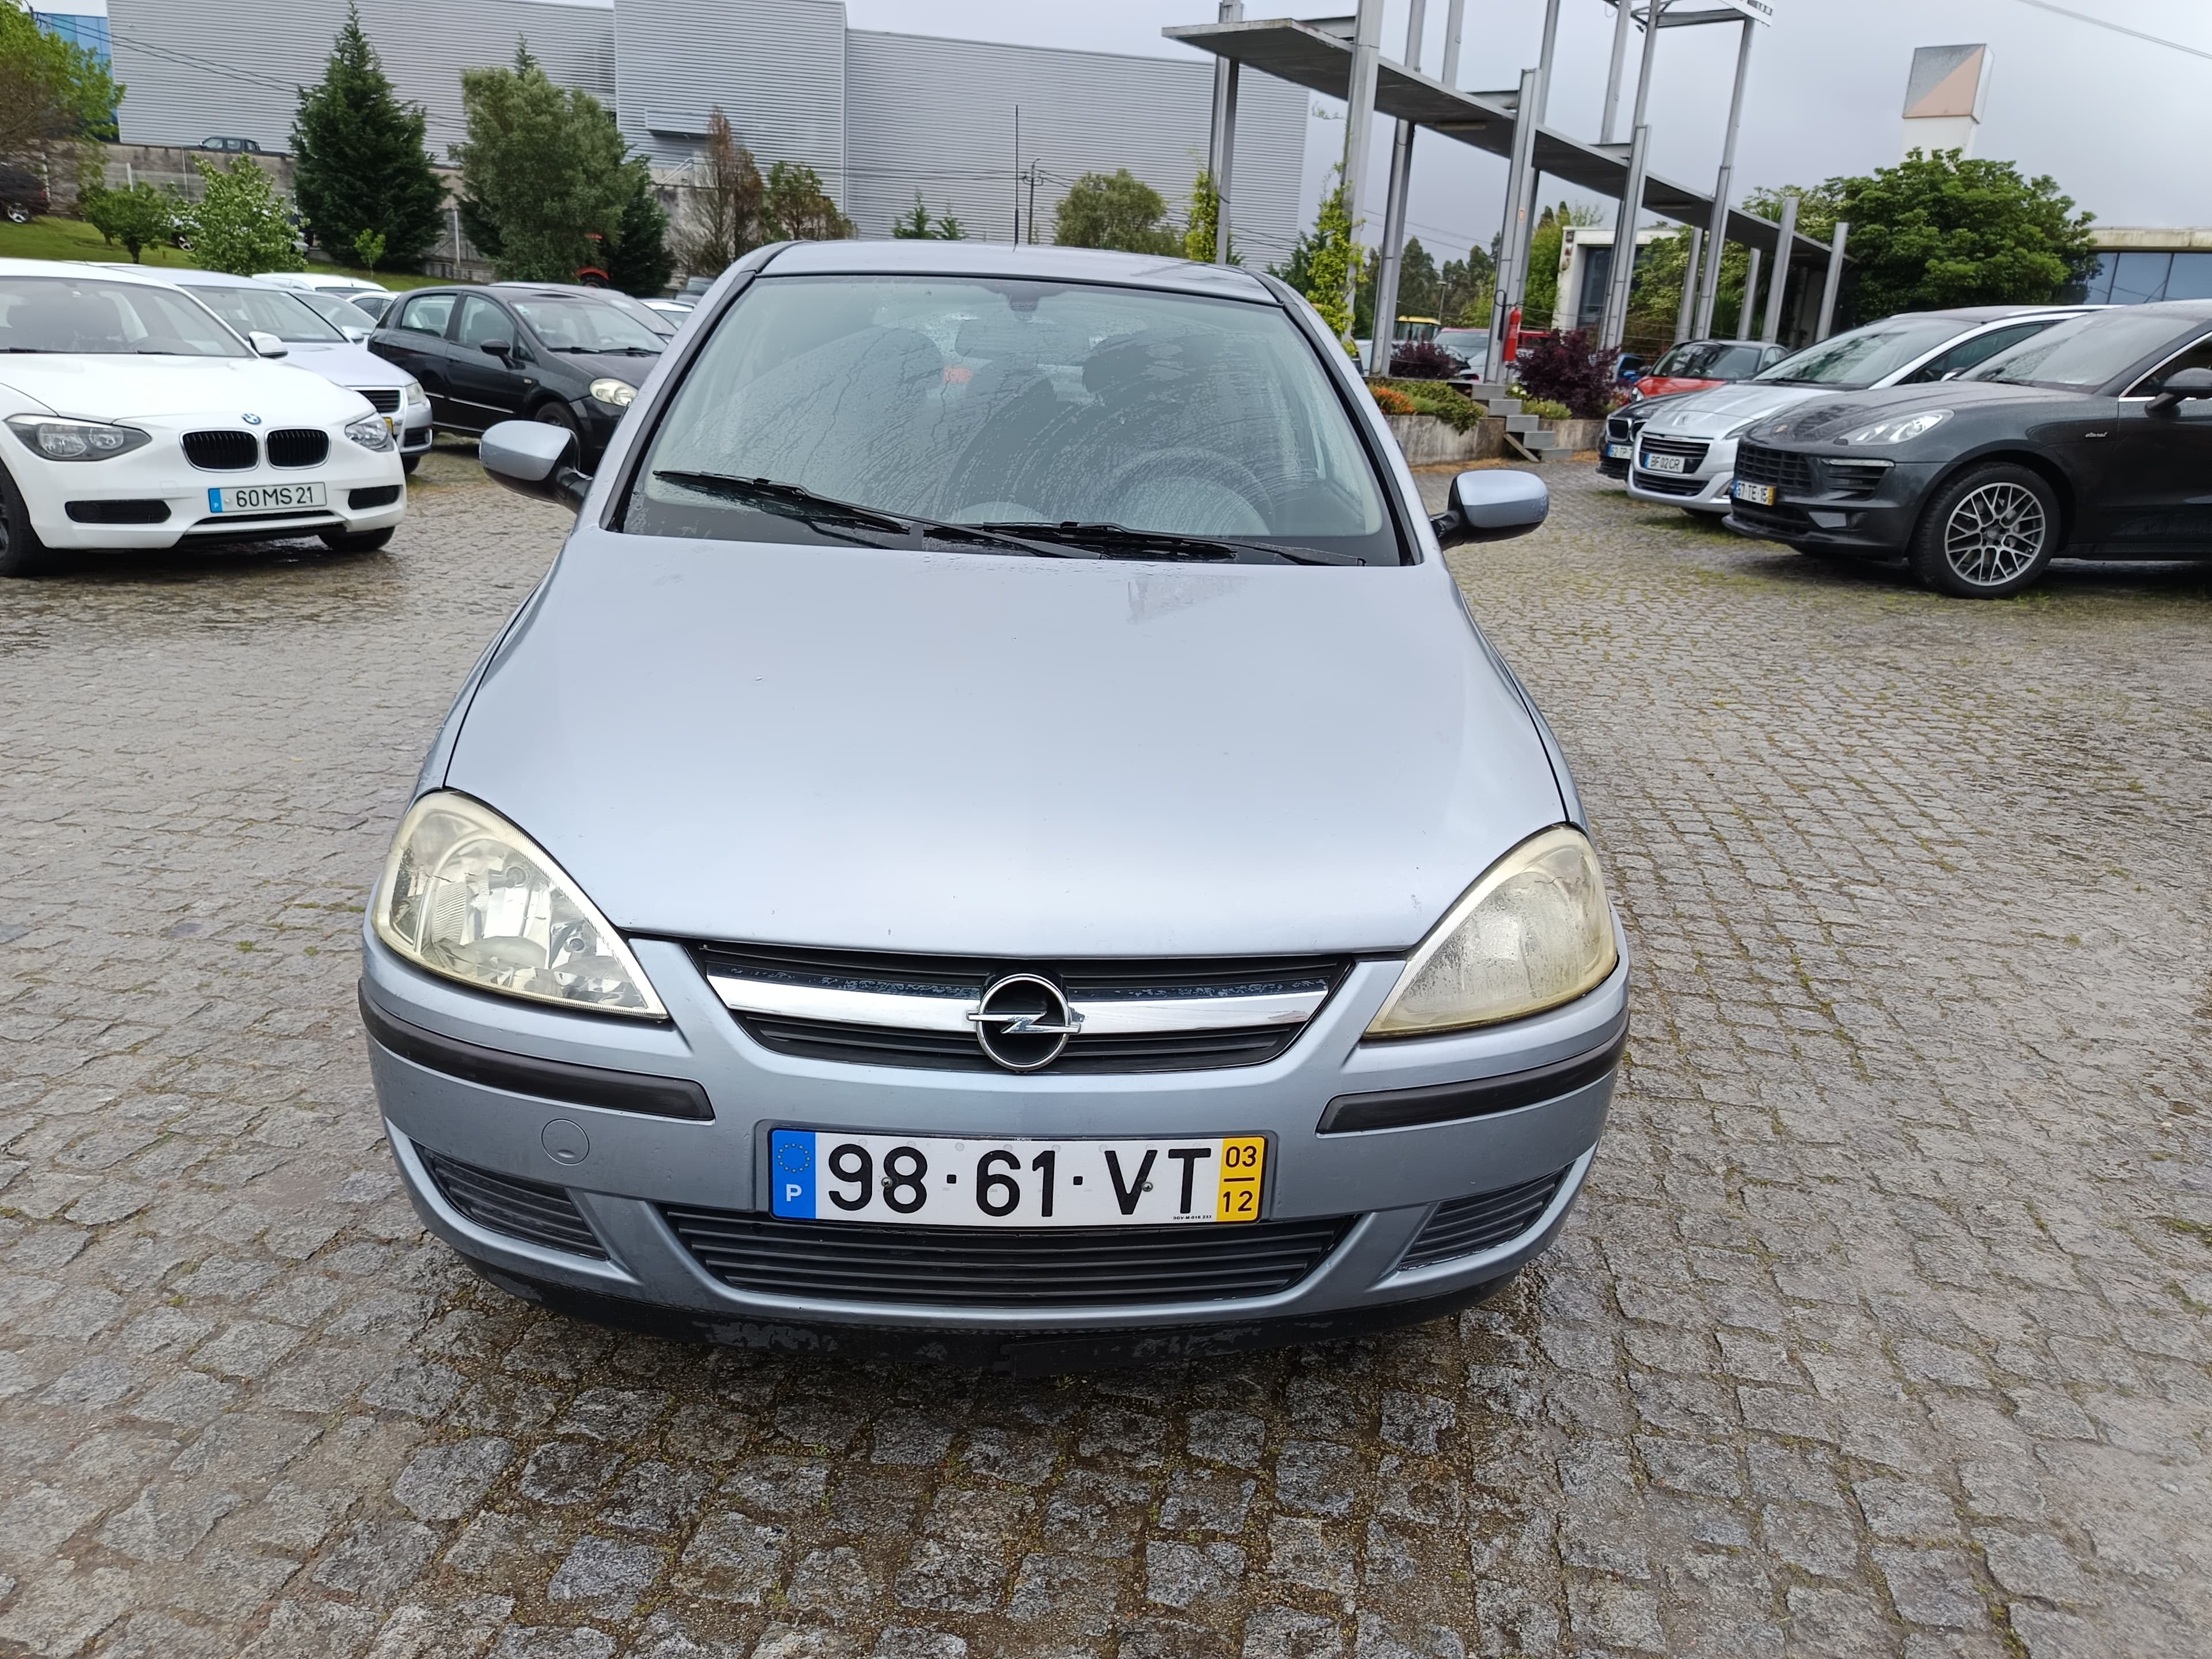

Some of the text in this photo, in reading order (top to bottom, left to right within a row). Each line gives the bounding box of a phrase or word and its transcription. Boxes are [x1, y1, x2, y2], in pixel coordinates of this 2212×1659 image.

[1225, 1145, 1257, 1168] 03
[786, 1184, 802, 1202] P
[1223, 1190, 1253, 1213] 12
